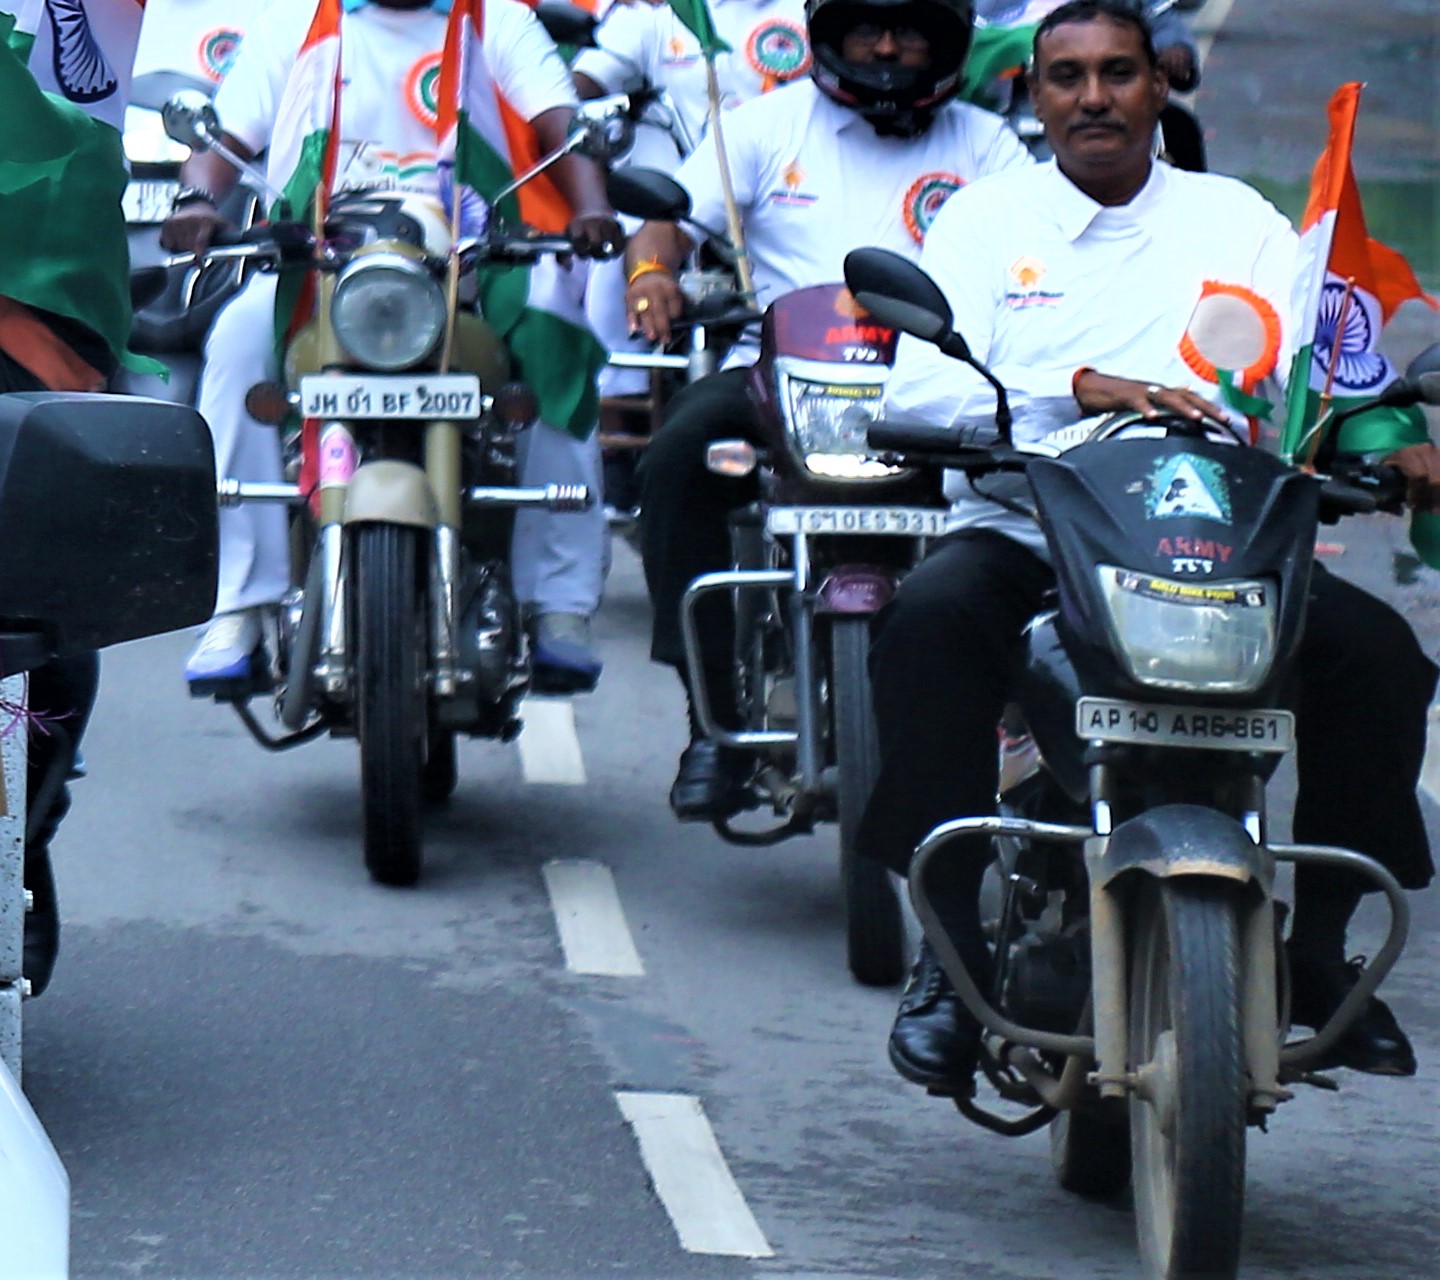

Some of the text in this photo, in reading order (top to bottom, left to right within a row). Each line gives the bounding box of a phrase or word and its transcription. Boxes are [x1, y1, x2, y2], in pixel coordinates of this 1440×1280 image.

[310, 393, 475, 413] JH 01 BF 2007
[1155, 536, 1232, 563] ARMY
[1090, 708, 1121, 728] AP
